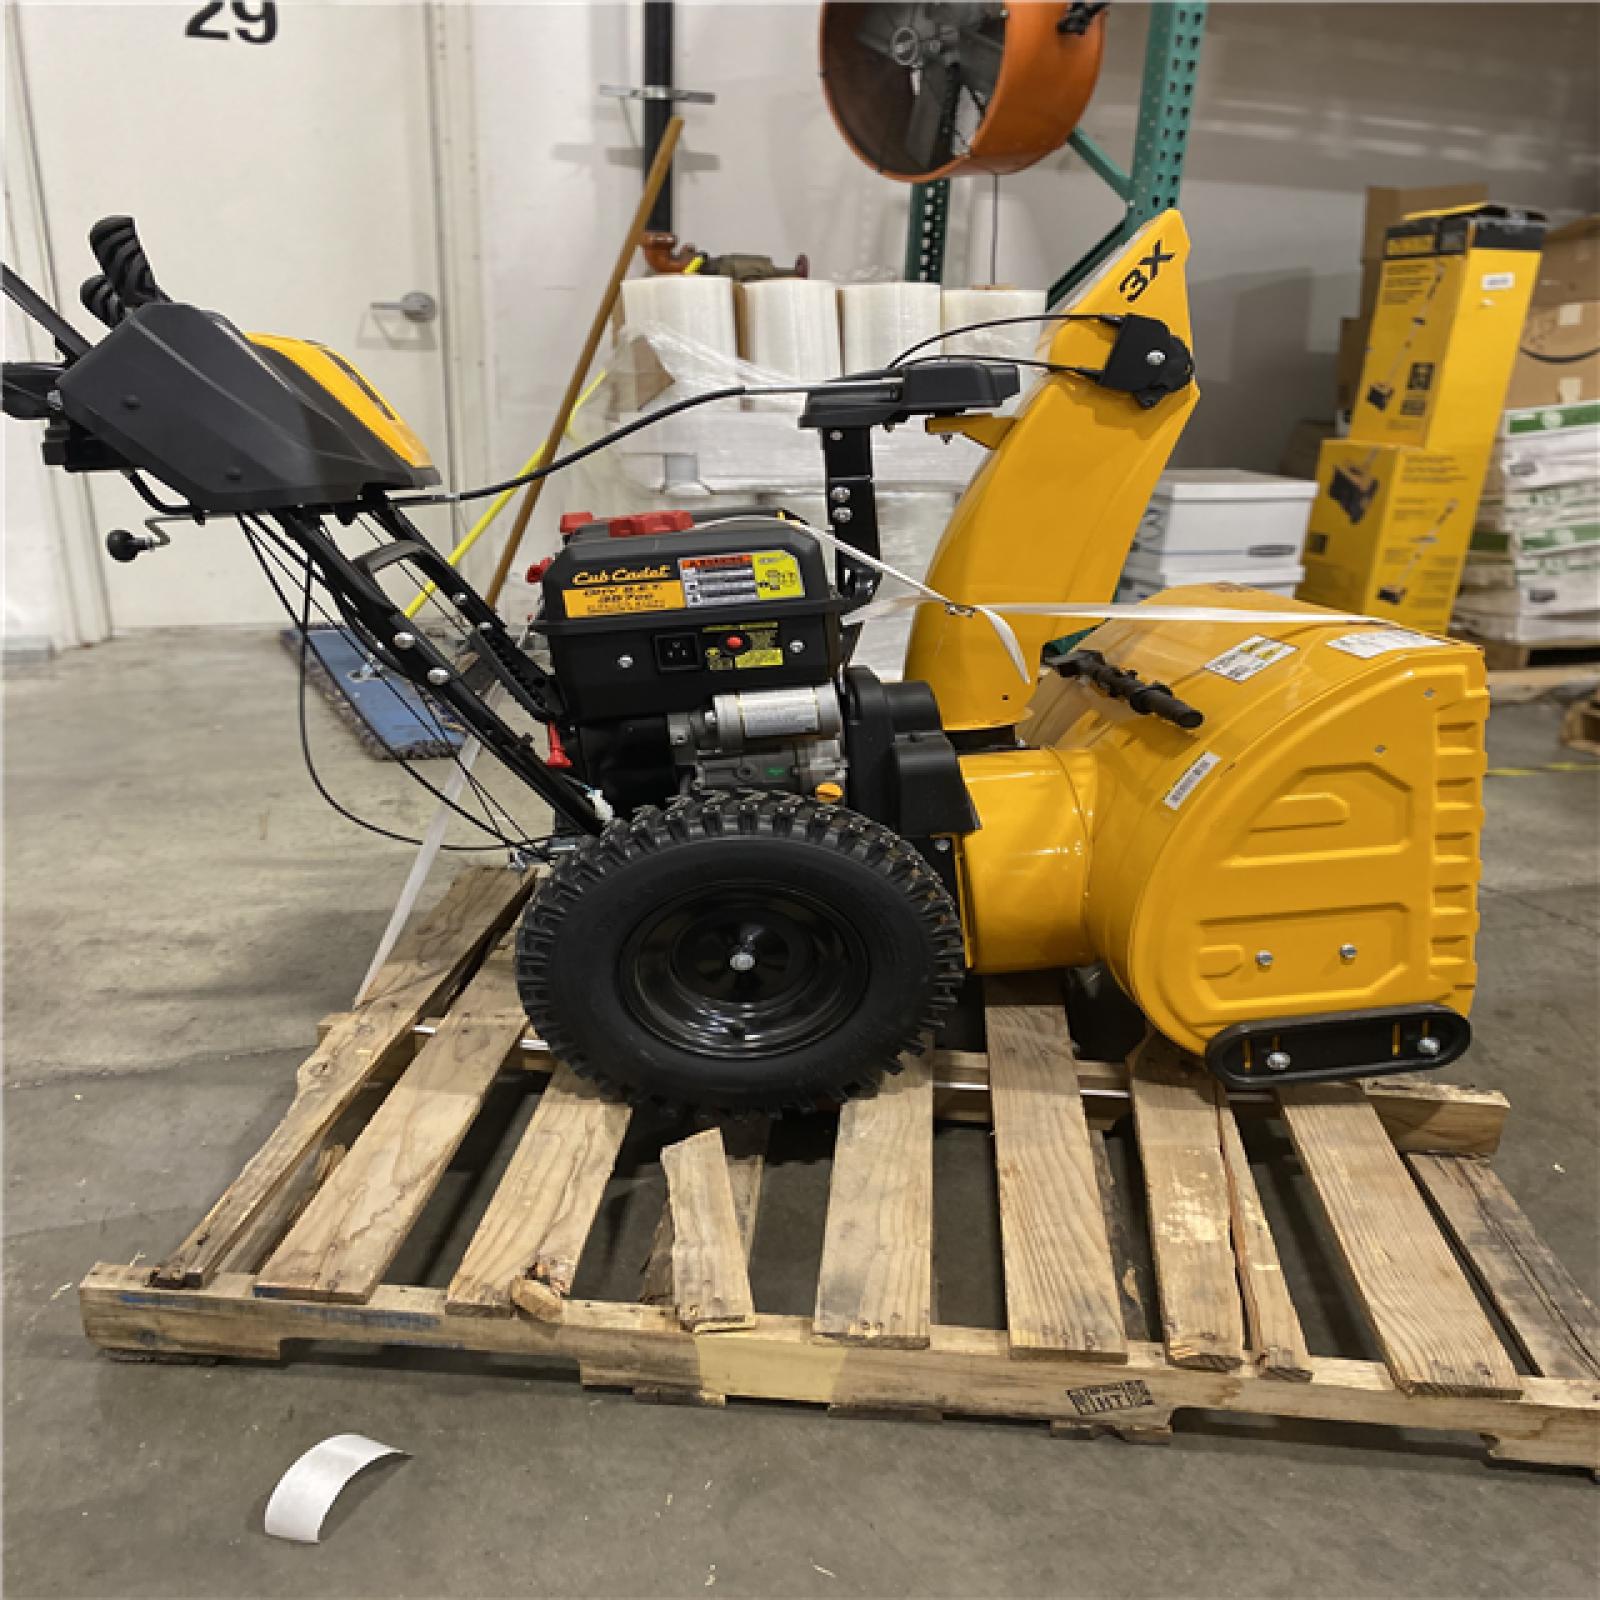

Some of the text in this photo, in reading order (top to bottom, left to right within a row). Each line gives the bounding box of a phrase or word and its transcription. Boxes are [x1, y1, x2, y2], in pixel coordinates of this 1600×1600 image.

[184, 1, 278, 45] 29
[1119, 239, 1176, 303] 3X
[572, 564, 671, 586] Cub Cadet
